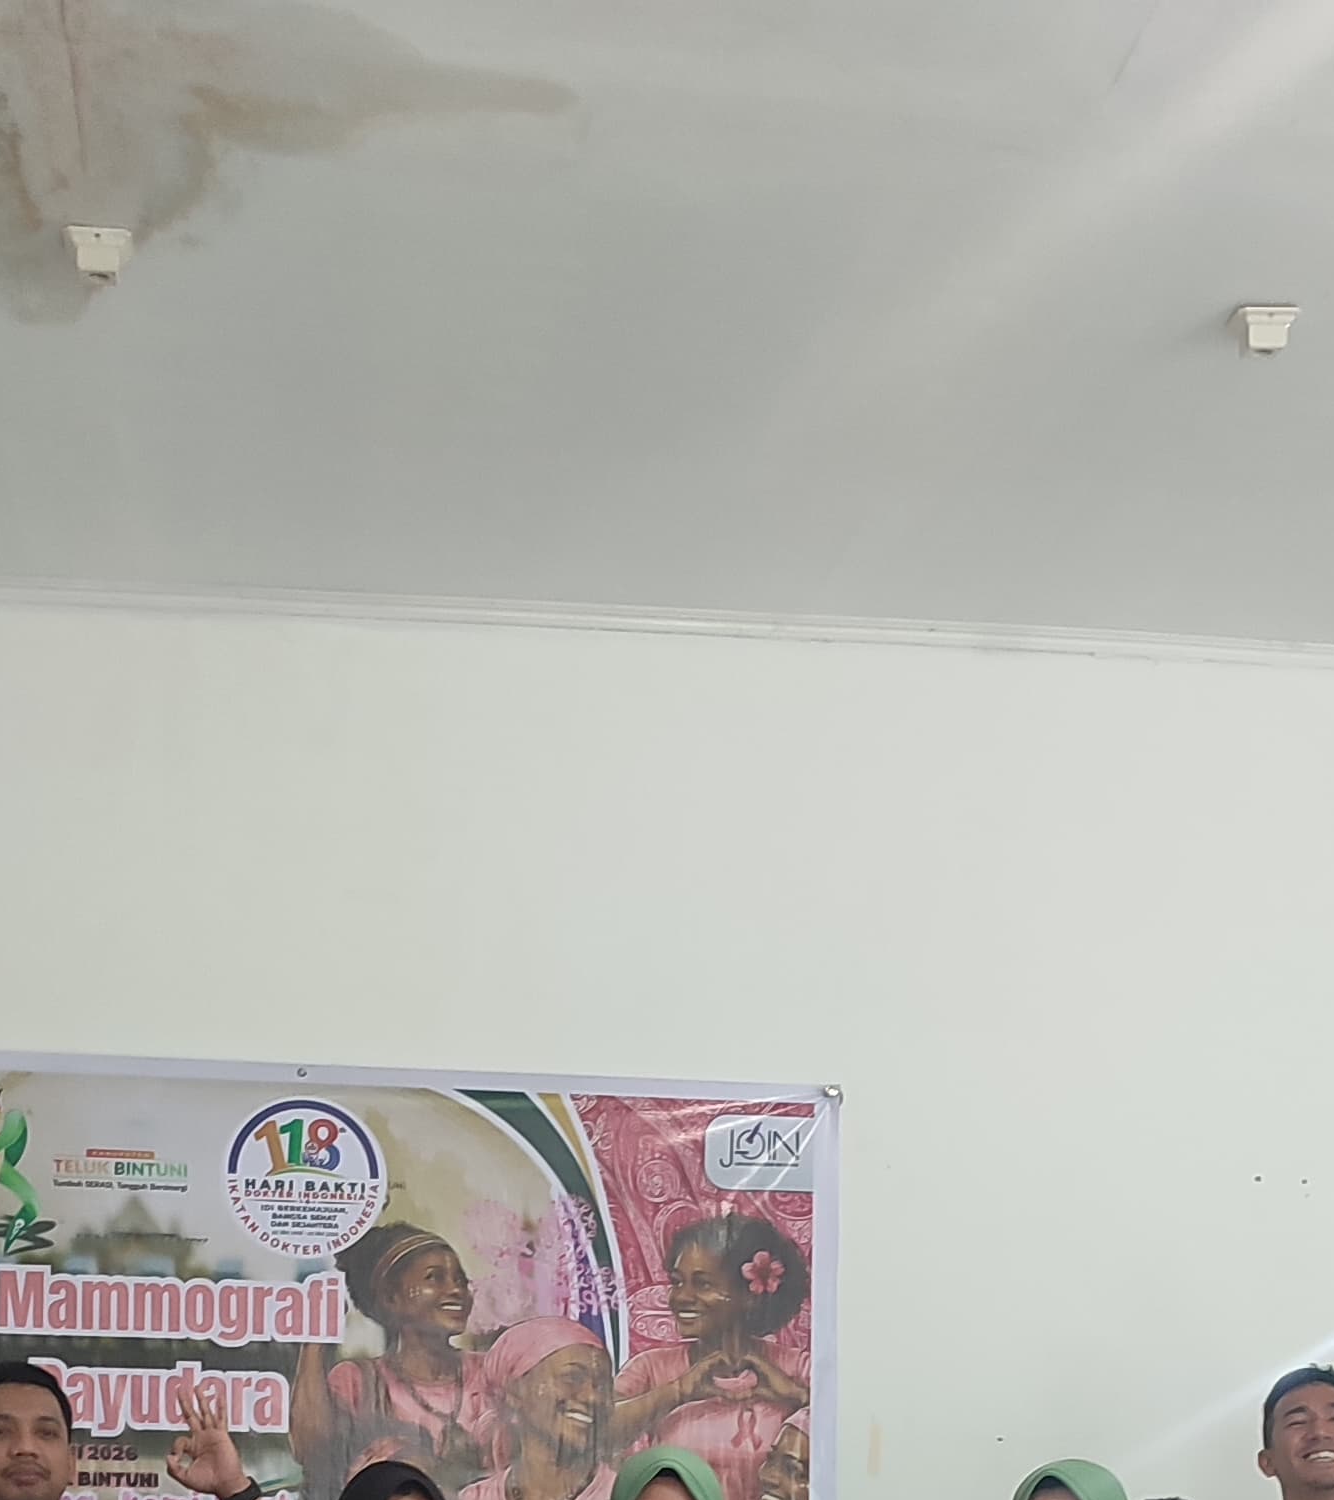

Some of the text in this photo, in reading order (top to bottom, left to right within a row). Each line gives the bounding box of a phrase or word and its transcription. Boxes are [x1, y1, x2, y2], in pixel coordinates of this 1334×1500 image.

[719, 1124, 799, 1168] JOIN
[53, 1159, 188, 1177] TELUK BINTUNI
[244, 1178, 366, 1193] HARI BAKTI
[244, 1189, 365, 1201] DOKTER INDONESIA
[227, 1178, 380, 1255] IKATAN DOKTER INDONESIA
[87, 1445, 139, 1461] 2026
[78, 1471, 159, 1488] BINTUNI
